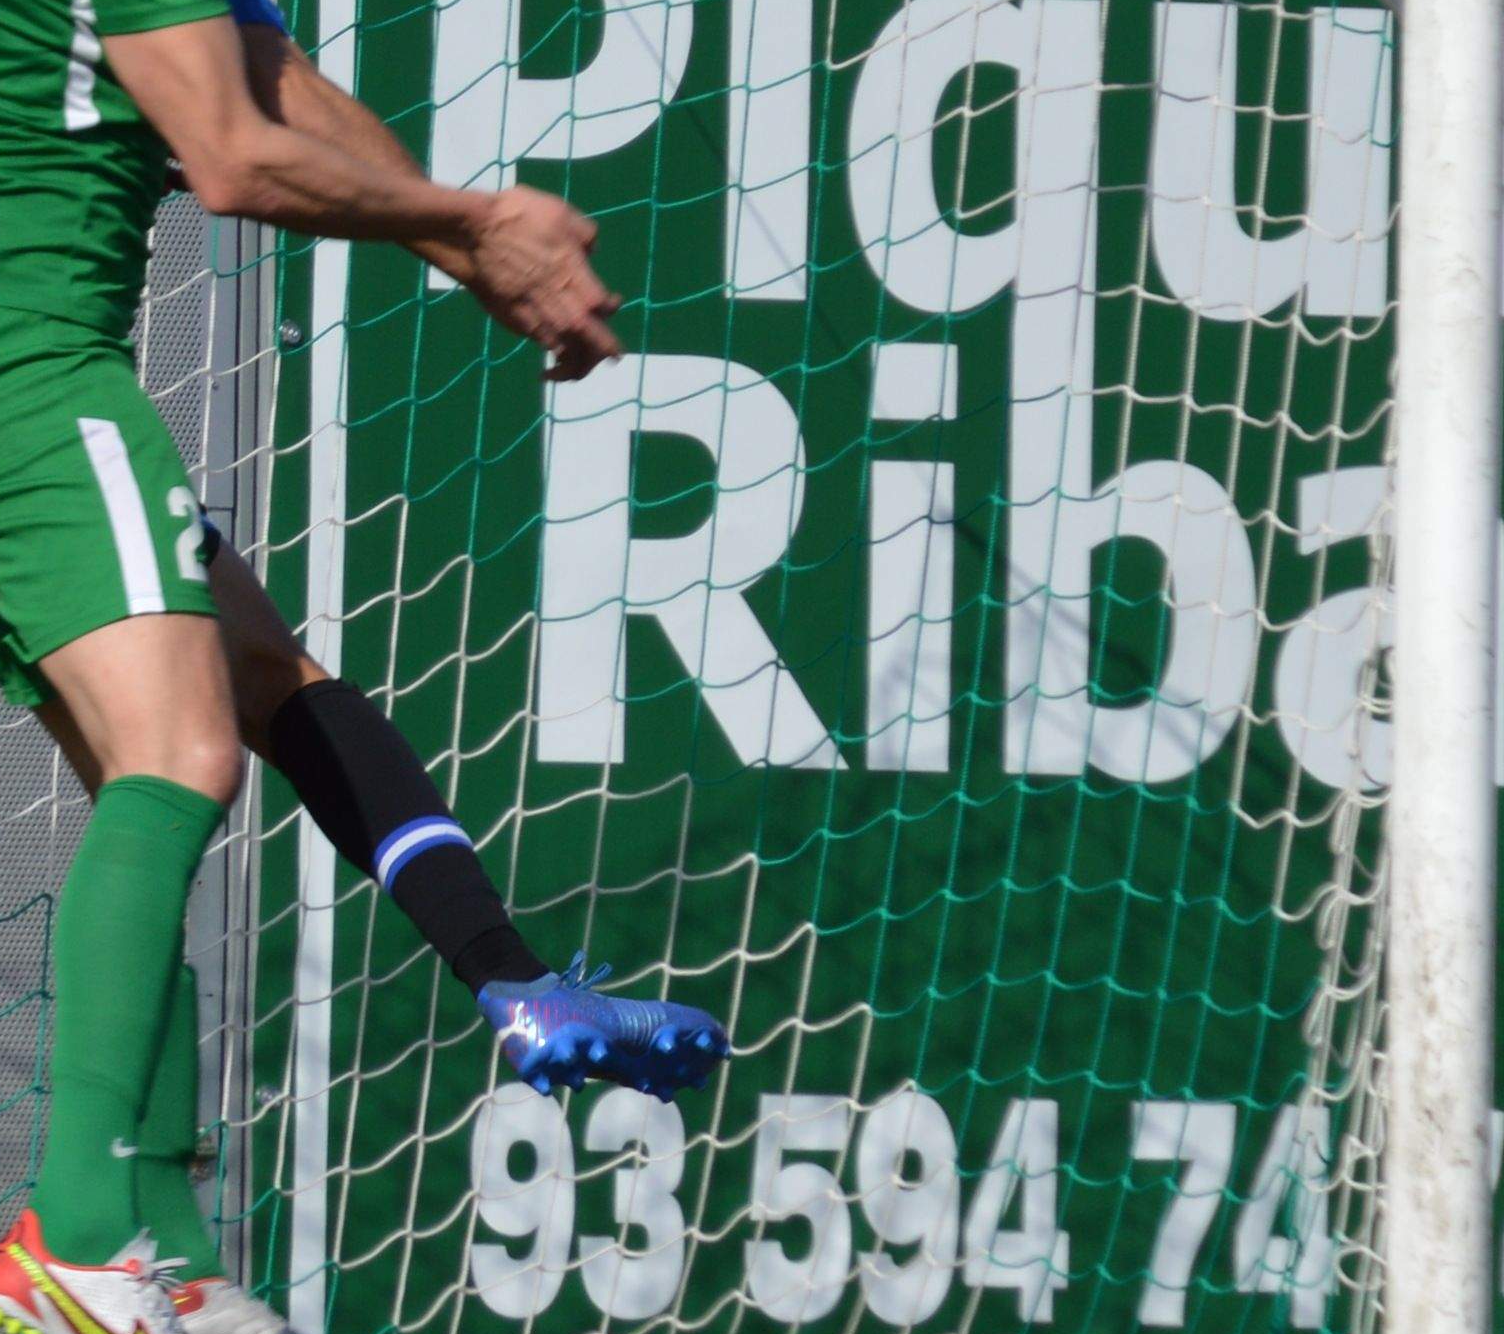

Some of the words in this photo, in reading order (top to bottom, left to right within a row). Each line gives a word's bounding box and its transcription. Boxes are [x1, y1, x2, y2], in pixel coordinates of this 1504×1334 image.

[468, 1083, 686, 1323] 93
[744, 1091, 1072, 1327] 594
[1130, 1098, 1333, 1330] 74
